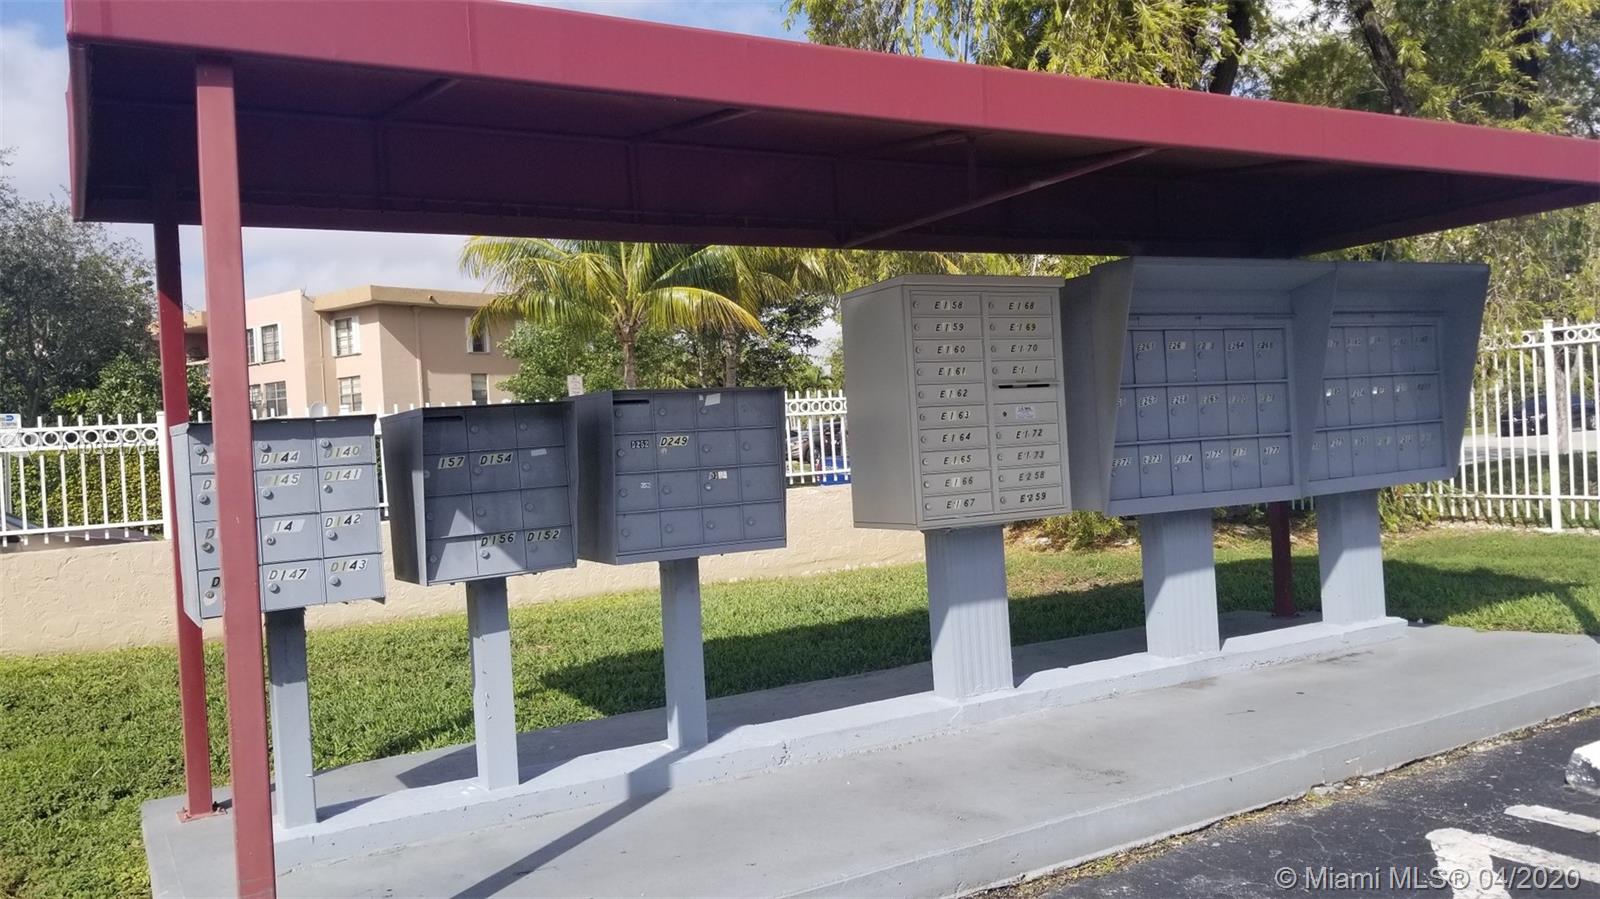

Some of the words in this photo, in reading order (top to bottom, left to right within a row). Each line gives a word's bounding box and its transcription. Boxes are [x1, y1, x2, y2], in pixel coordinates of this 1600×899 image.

[934, 301, 963, 310] E158
[1008, 301, 1035, 310] E168
[935, 323, 964, 332] E159
[1009, 323, 1037, 332] E169
[937, 345, 966, 354] E160
[1010, 344, 1038, 353] E170
[938, 367, 966, 376] E161
[939, 389, 968, 399] E162
[940, 411, 970, 421] E163
[942, 432, 971, 442] E164
[1016, 429, 1043, 439] E172
[660, 436, 689, 447] D249
[261, 452, 300, 464] D144
[324, 446, 360, 459] D140
[1017, 450, 1045, 461] E173
[440, 456, 465, 468] 157
[480, 453, 513, 466] D154
[943, 455, 972, 465] E165
[324, 468, 360, 481] D141
[1018, 471, 1045, 482] E258
[945, 476, 974, 487] E166
[1019, 491, 1047, 503] E259
[946, 498, 976, 509] E167
[325, 514, 362, 527] D142
[481, 533, 515, 547] D156
[527, 530, 561, 542] D152
[330, 558, 368, 572] D143
[268, 568, 307, 580] D147
